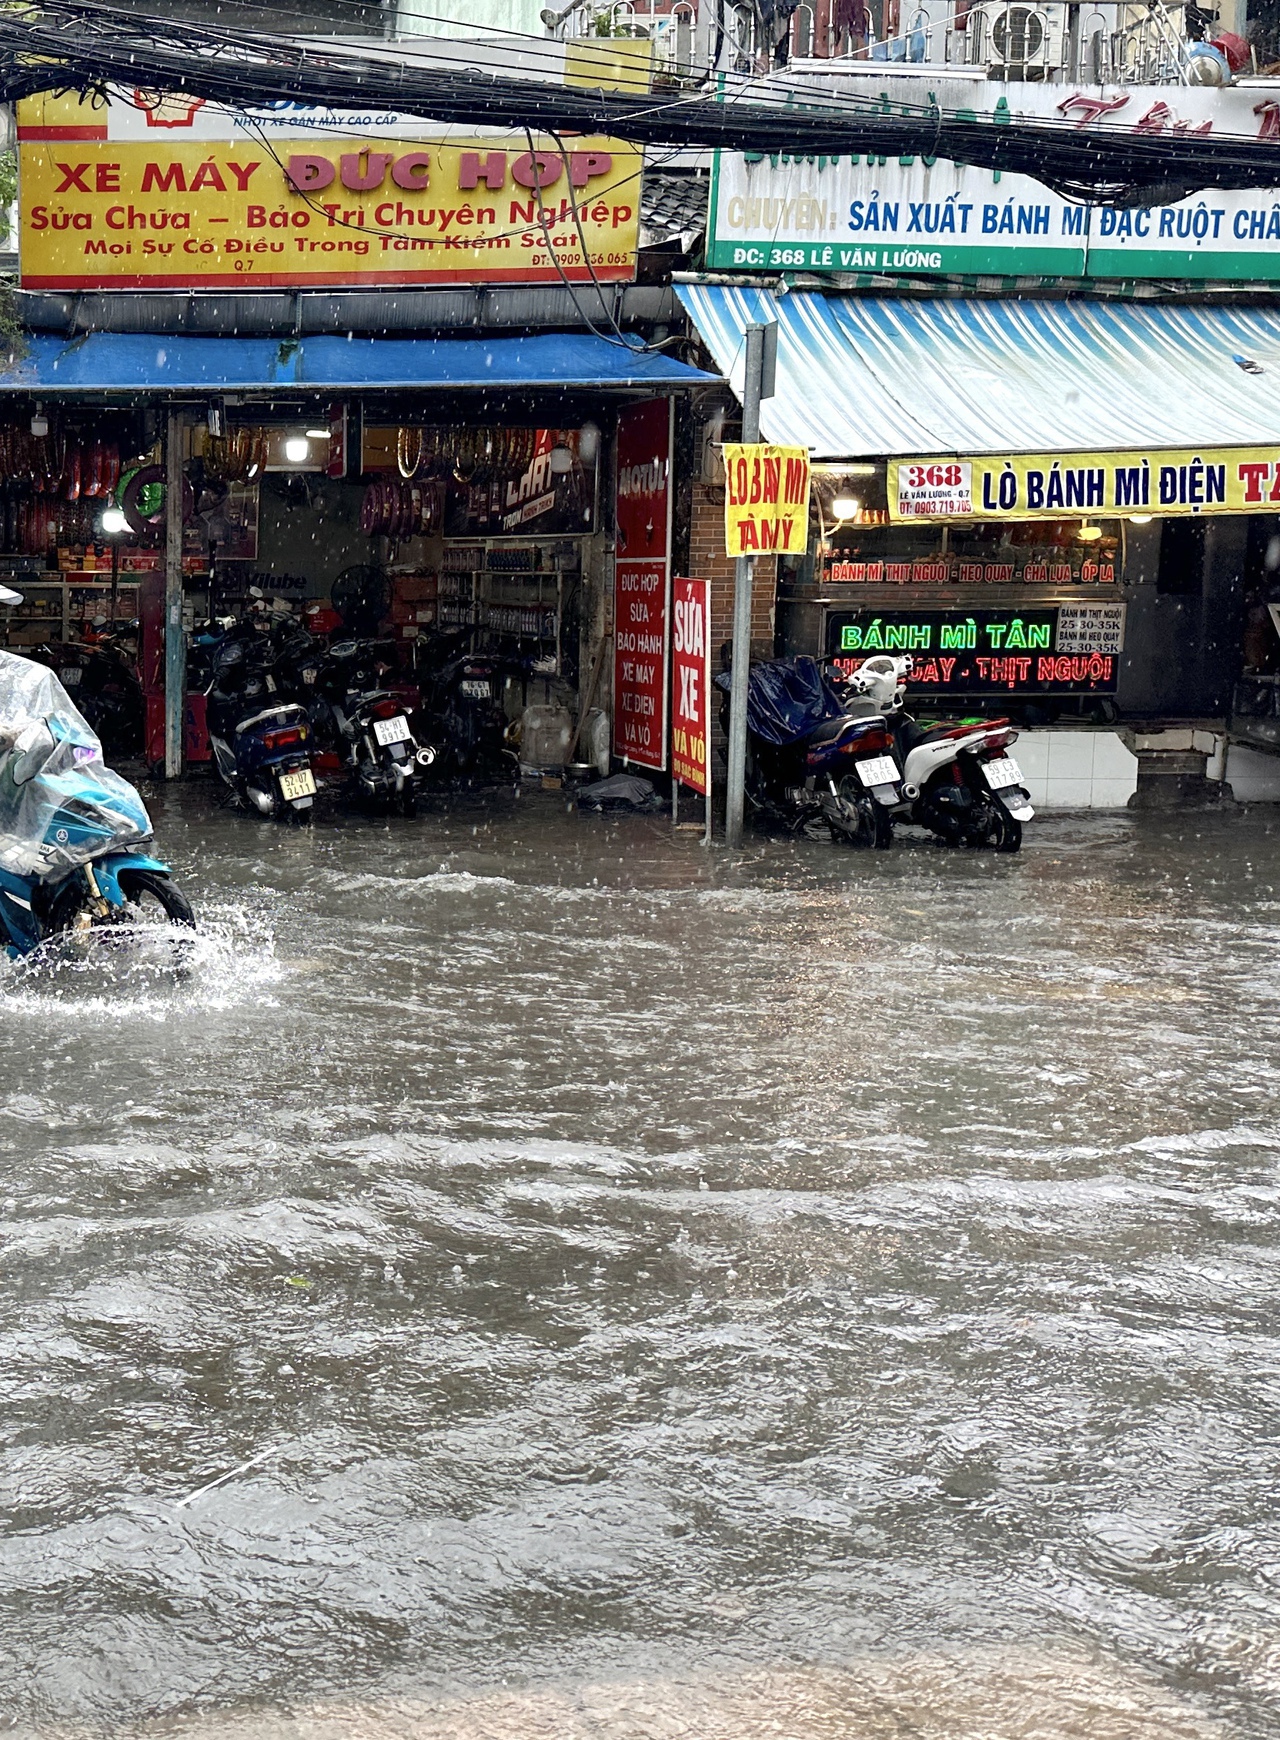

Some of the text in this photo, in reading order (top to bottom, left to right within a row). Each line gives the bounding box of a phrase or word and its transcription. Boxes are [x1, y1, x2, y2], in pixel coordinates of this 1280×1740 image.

[348, 115, 372, 125] CAO
[375, 110, 399, 124] CẤP
[54, 145, 613, 199] XE MÁY ĐỨC HỢP
[30, 200, 632, 232] Sửa Chữa Bảo Trì Chuyên Nghiệp
[848, 190, 900, 231] SẢN
[906, 191, 973, 233] XUẤT
[982, 197, 1050, 235] BÁNH
[1159, 202, 1225, 245] RUỘT
[84, 239, 131, 258] Mọi
[142, 238, 175, 257] Sự
[183, 237, 215, 254] Cố
[224, 236, 284, 254] Điều
[294, 237, 370, 255] Trong
[520, 232, 579, 248] Soát
[532, 254, 550, 265] ĐT:
[607, 252, 628, 264] 065
[734, 246, 942, 268] ĐC: 368 LÊ VĂN LƯƠNG
[234, 260, 254, 271] Q.7
[619, 461, 665, 496] MOTUL
[727, 446, 808, 506] LÒ MÌ
[908, 465, 962, 487] 368
[983, 462, 1017, 511] LÒ
[1027, 461, 1105, 509] BÁNH
[1115, 458, 1150, 506] MÌ
[1159, 457, 1226, 513] ĐIỆN
[621, 569, 659, 596] ĐỨC HỢP
[831, 560, 866, 582] BÁNH
[867, 560, 883, 582] MÌ
[885, 563, 911, 585] THỊT
[912, 560, 950, 585] NGUỘI
[959, 563, 983, 582] HEO
[985, 563, 1014, 583] QUAY
[1049, 563, 1072, 584] LỤA
[1081, 558, 1098, 582] ỐP
[1099, 563, 1114, 582] LA
[630, 598, 649, 622] SỬA
[674, 582, 705, 658] SỬA
[841, 617, 1051, 650] BÁNH MÌ TÂN
[1060, 619, 1120, 630] 25-30-35K
[617, 627, 662, 656] BẢO HÀNH
[1058, 642, 1119, 652] 25-30-35K
[636, 659, 655, 685] MÁY
[976, 651, 1112, 688] THỊT NGUỘI
[634, 692, 655, 720] ĐIỆN
[678, 664, 699, 723] XE
[381, 729, 406, 743] 9915
[624, 718, 651, 746] VÁ VỎ
[673, 726, 688, 757] VÁ
[690, 730, 705, 765] VỎ
[287, 783, 311, 798] 3411
